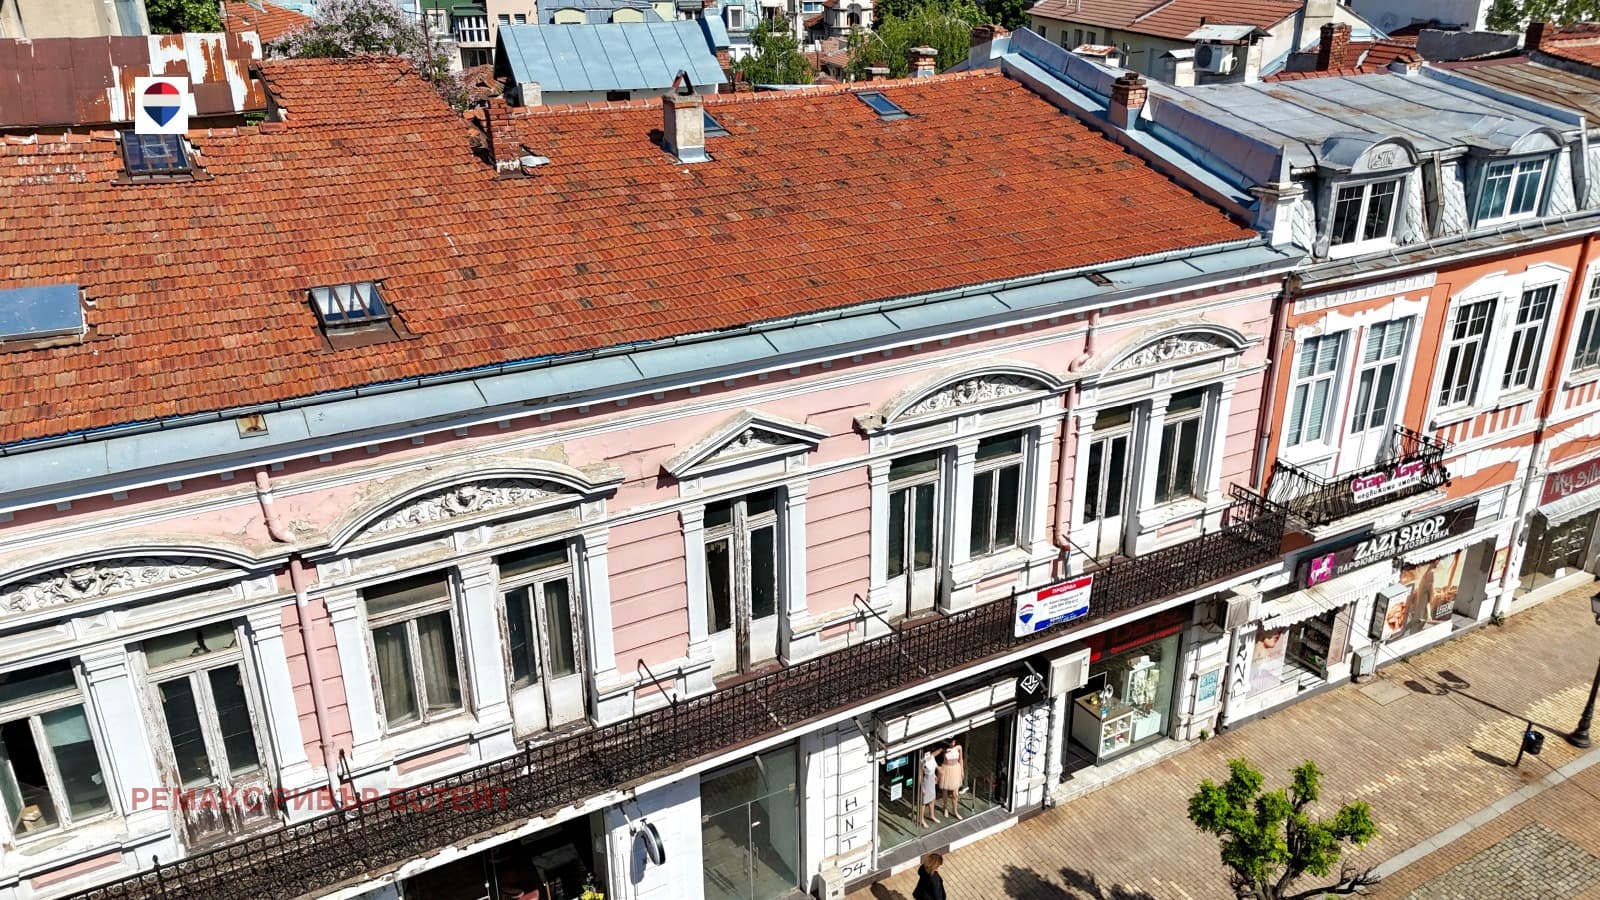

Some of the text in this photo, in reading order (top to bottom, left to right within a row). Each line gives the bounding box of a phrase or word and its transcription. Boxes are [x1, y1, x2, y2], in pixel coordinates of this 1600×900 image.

[1352, 473, 1386, 492] Стар
[1337, 529, 1450, 574] ПАРФЮМЕРИЯ И КОЗМЕТИКА
[1355, 516, 1446, 560] ZAZI SHOP
